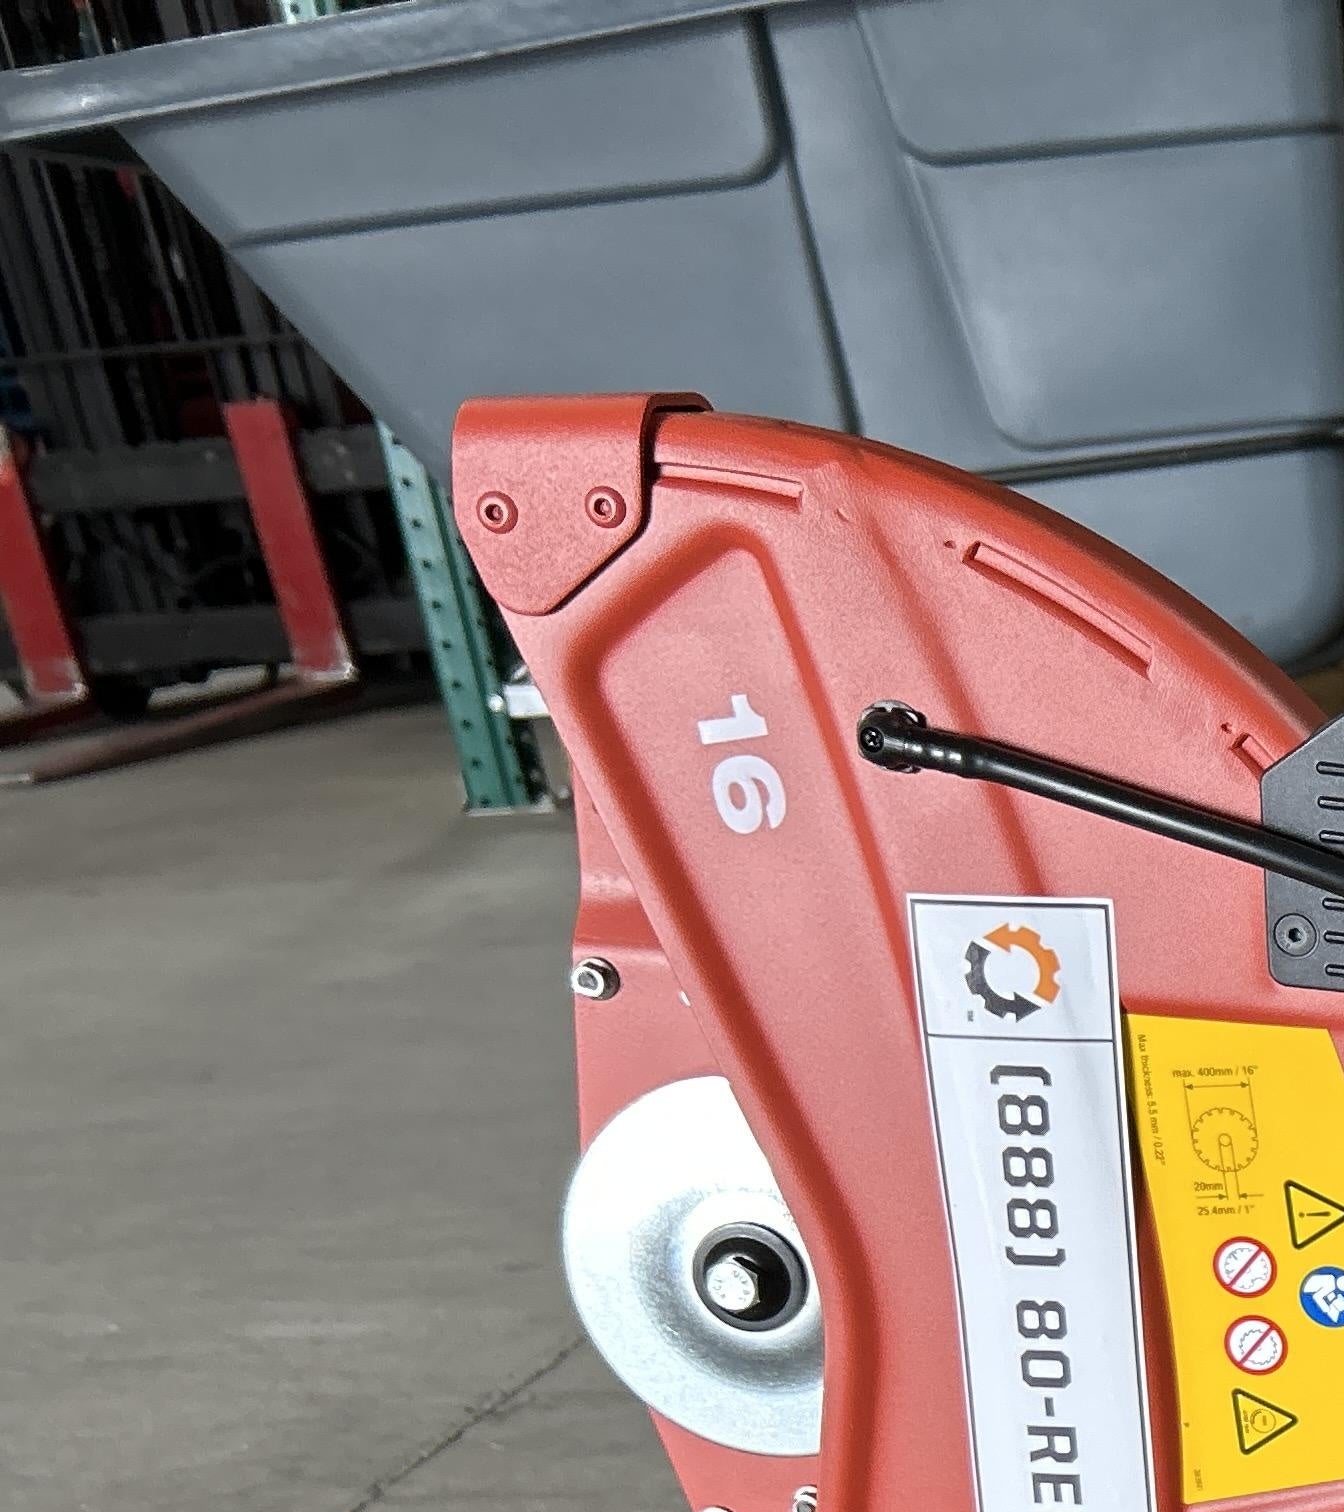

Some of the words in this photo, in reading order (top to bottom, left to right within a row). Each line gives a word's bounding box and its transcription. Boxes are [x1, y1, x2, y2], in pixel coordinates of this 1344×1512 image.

[697, 693, 787, 835] 16
[1197, 1067, 1233, 1077] 400mm
[990, 1065, 1066, 1267] (888)
[1193, 1181, 1224, 1191] 20mm
